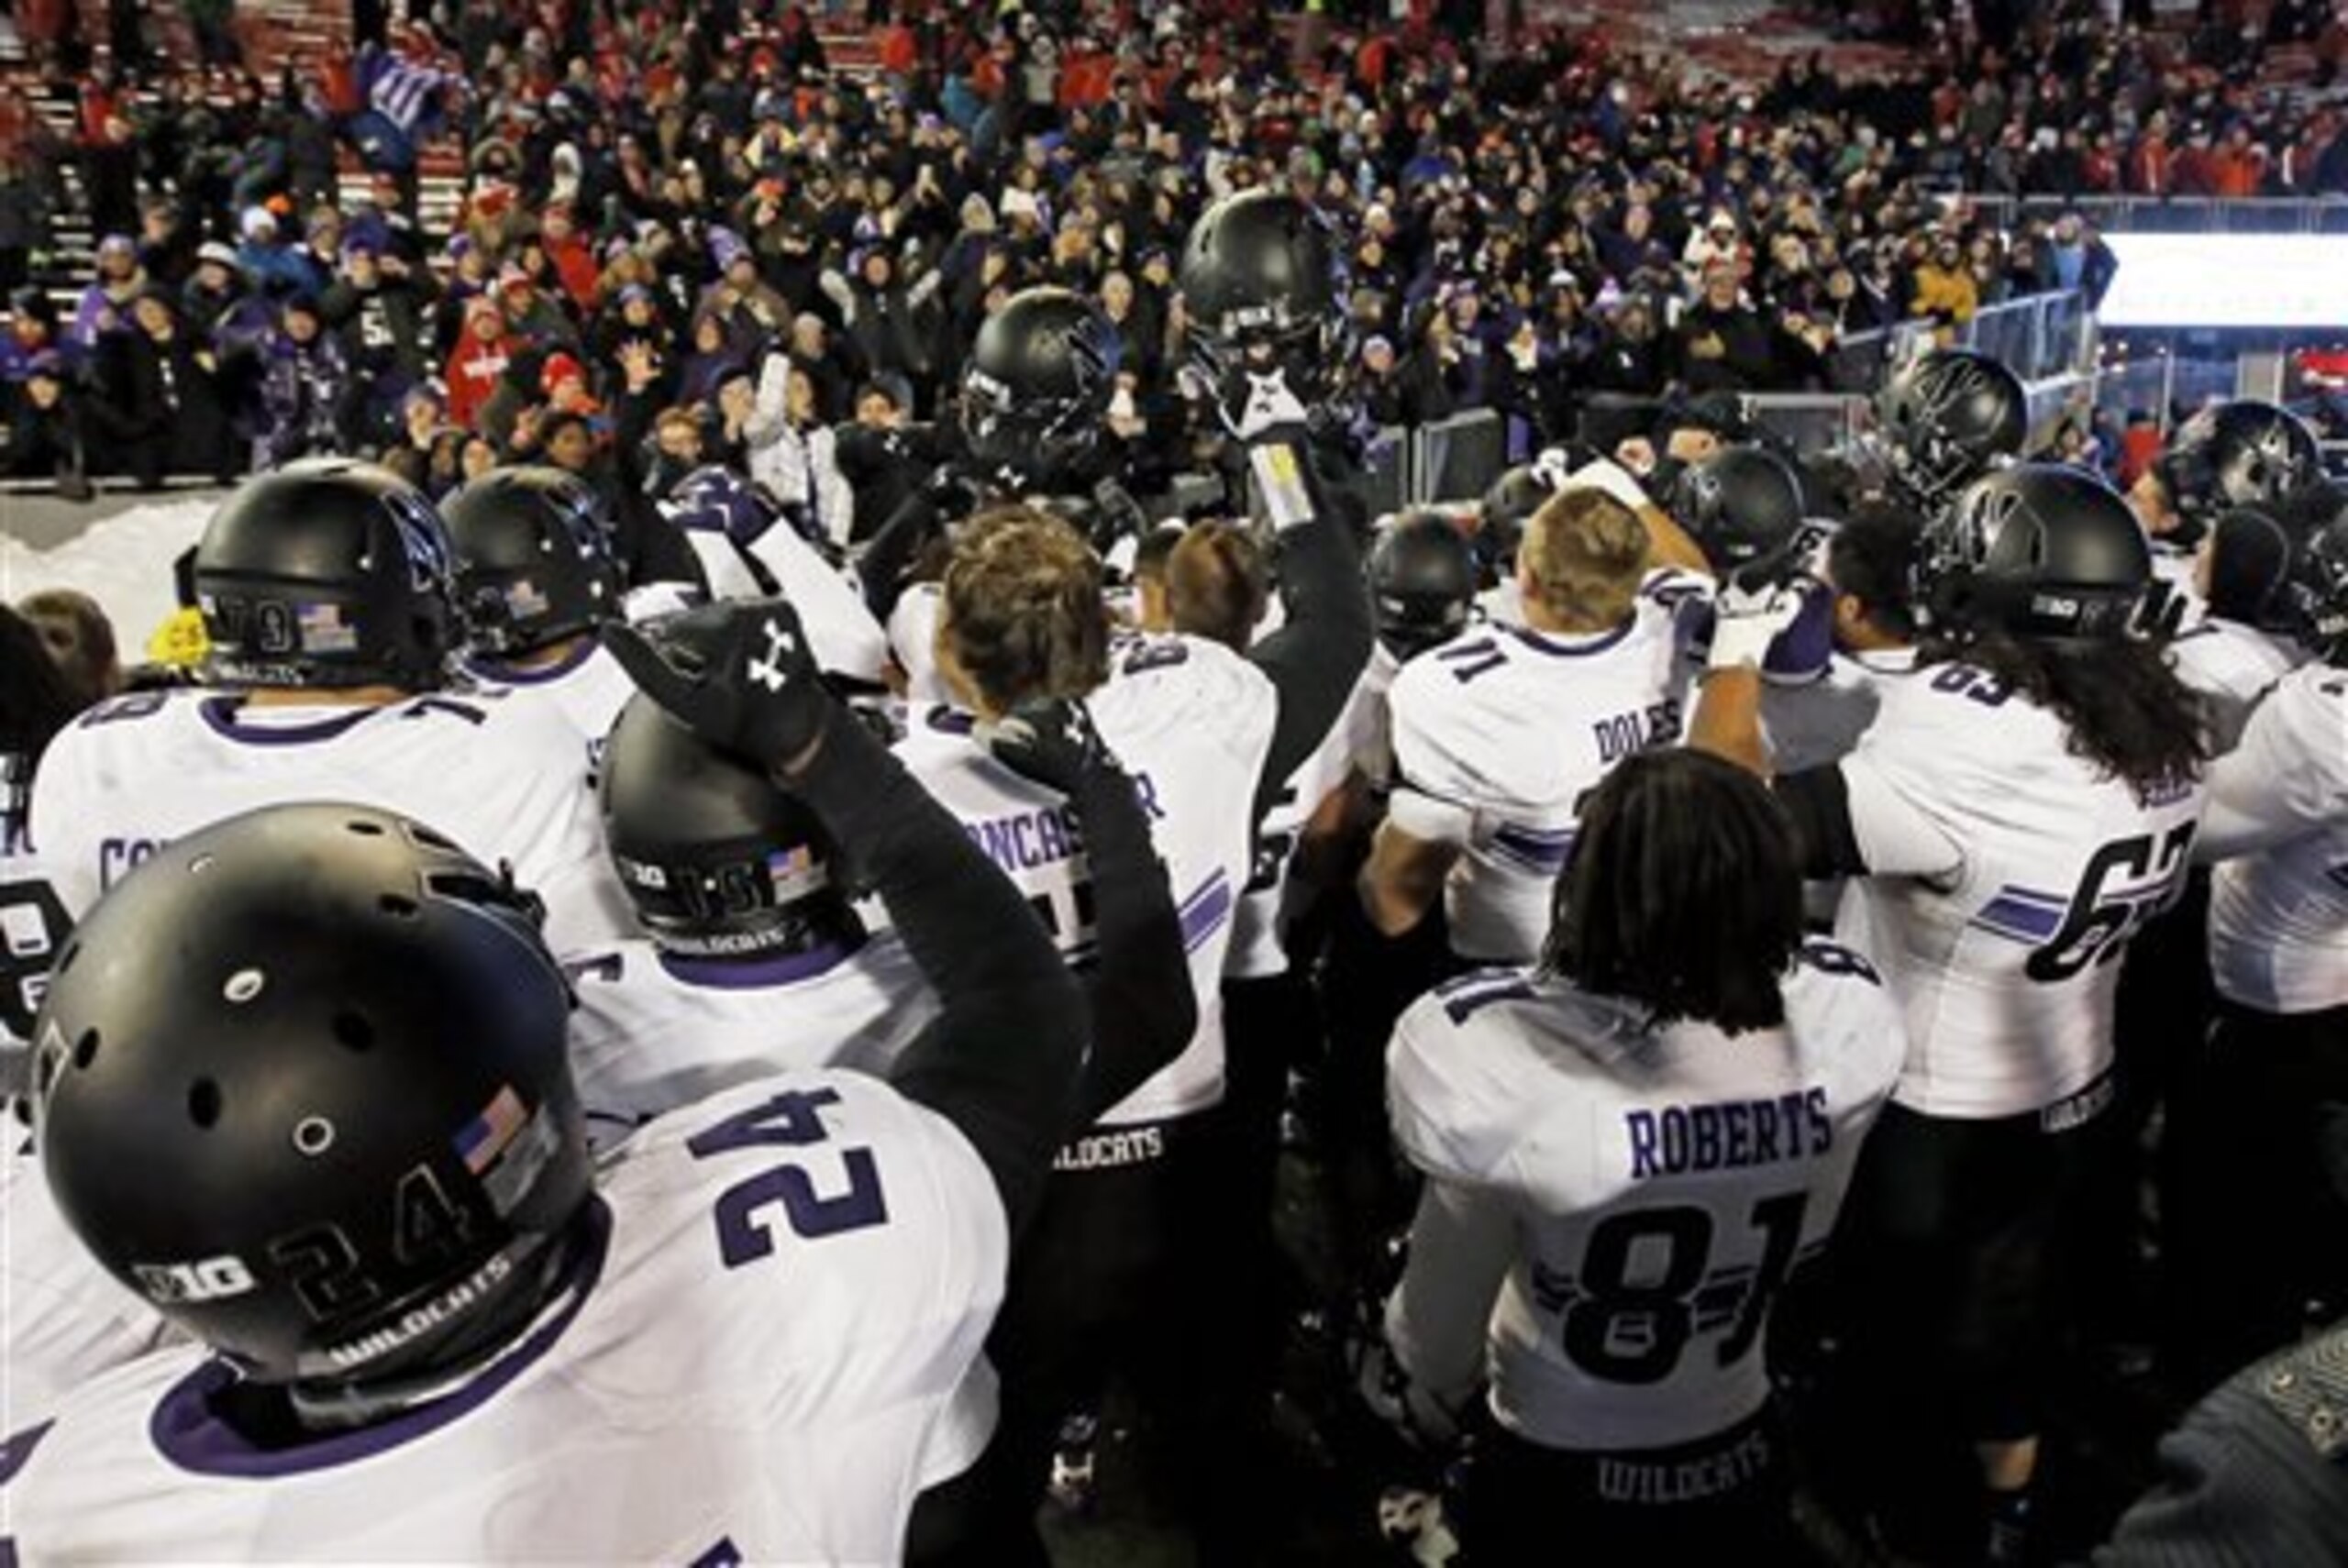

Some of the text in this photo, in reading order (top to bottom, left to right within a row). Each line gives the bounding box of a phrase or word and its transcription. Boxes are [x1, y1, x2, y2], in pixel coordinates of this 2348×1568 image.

[685, 1086, 889, 1270] 24
[1053, 1126, 1163, 1171] LDCATS
[1626, 1087, 1833, 1179] ROBERTS
[270, 1162, 470, 1323] 24
[1562, 1191, 1811, 1386] 81
[327, 1253, 513, 1368] WILDCATS
[1598, 1428, 1769, 1505] WILDCATS
